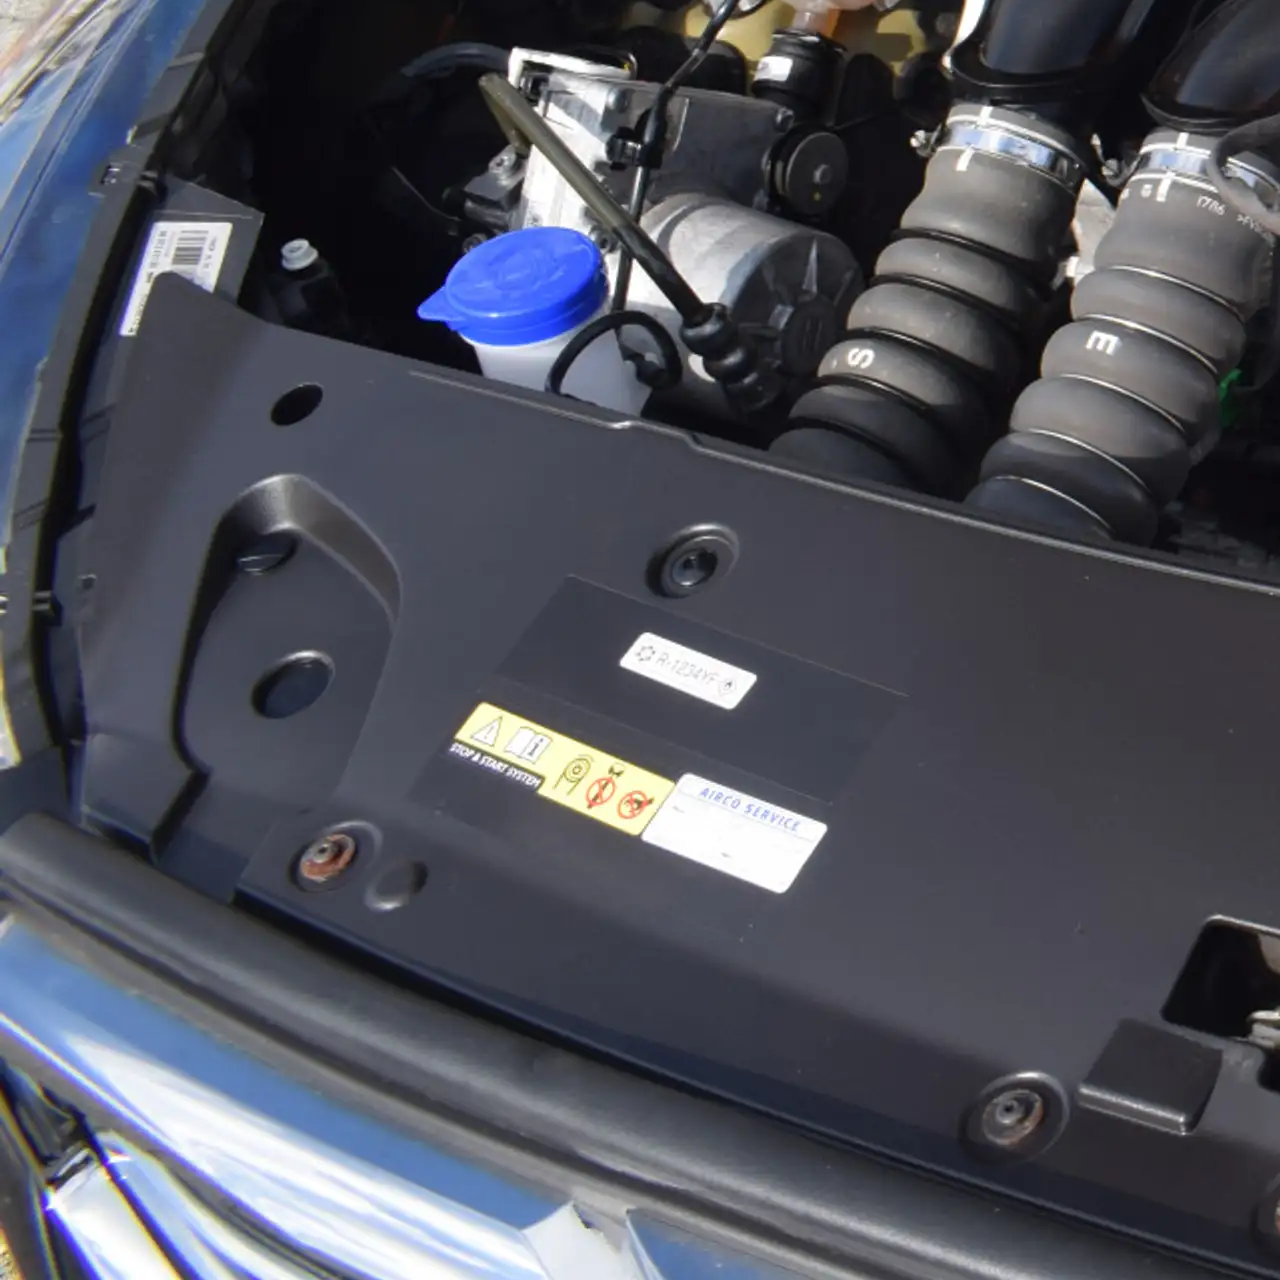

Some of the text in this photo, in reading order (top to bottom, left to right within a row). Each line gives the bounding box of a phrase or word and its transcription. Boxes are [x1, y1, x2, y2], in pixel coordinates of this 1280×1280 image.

[449, 742, 474, 762] STOP
[481, 754, 508, 775] START
[506, 765, 541, 788] SYSTEM
[700, 786, 801, 832] AIRCO SERVICE
